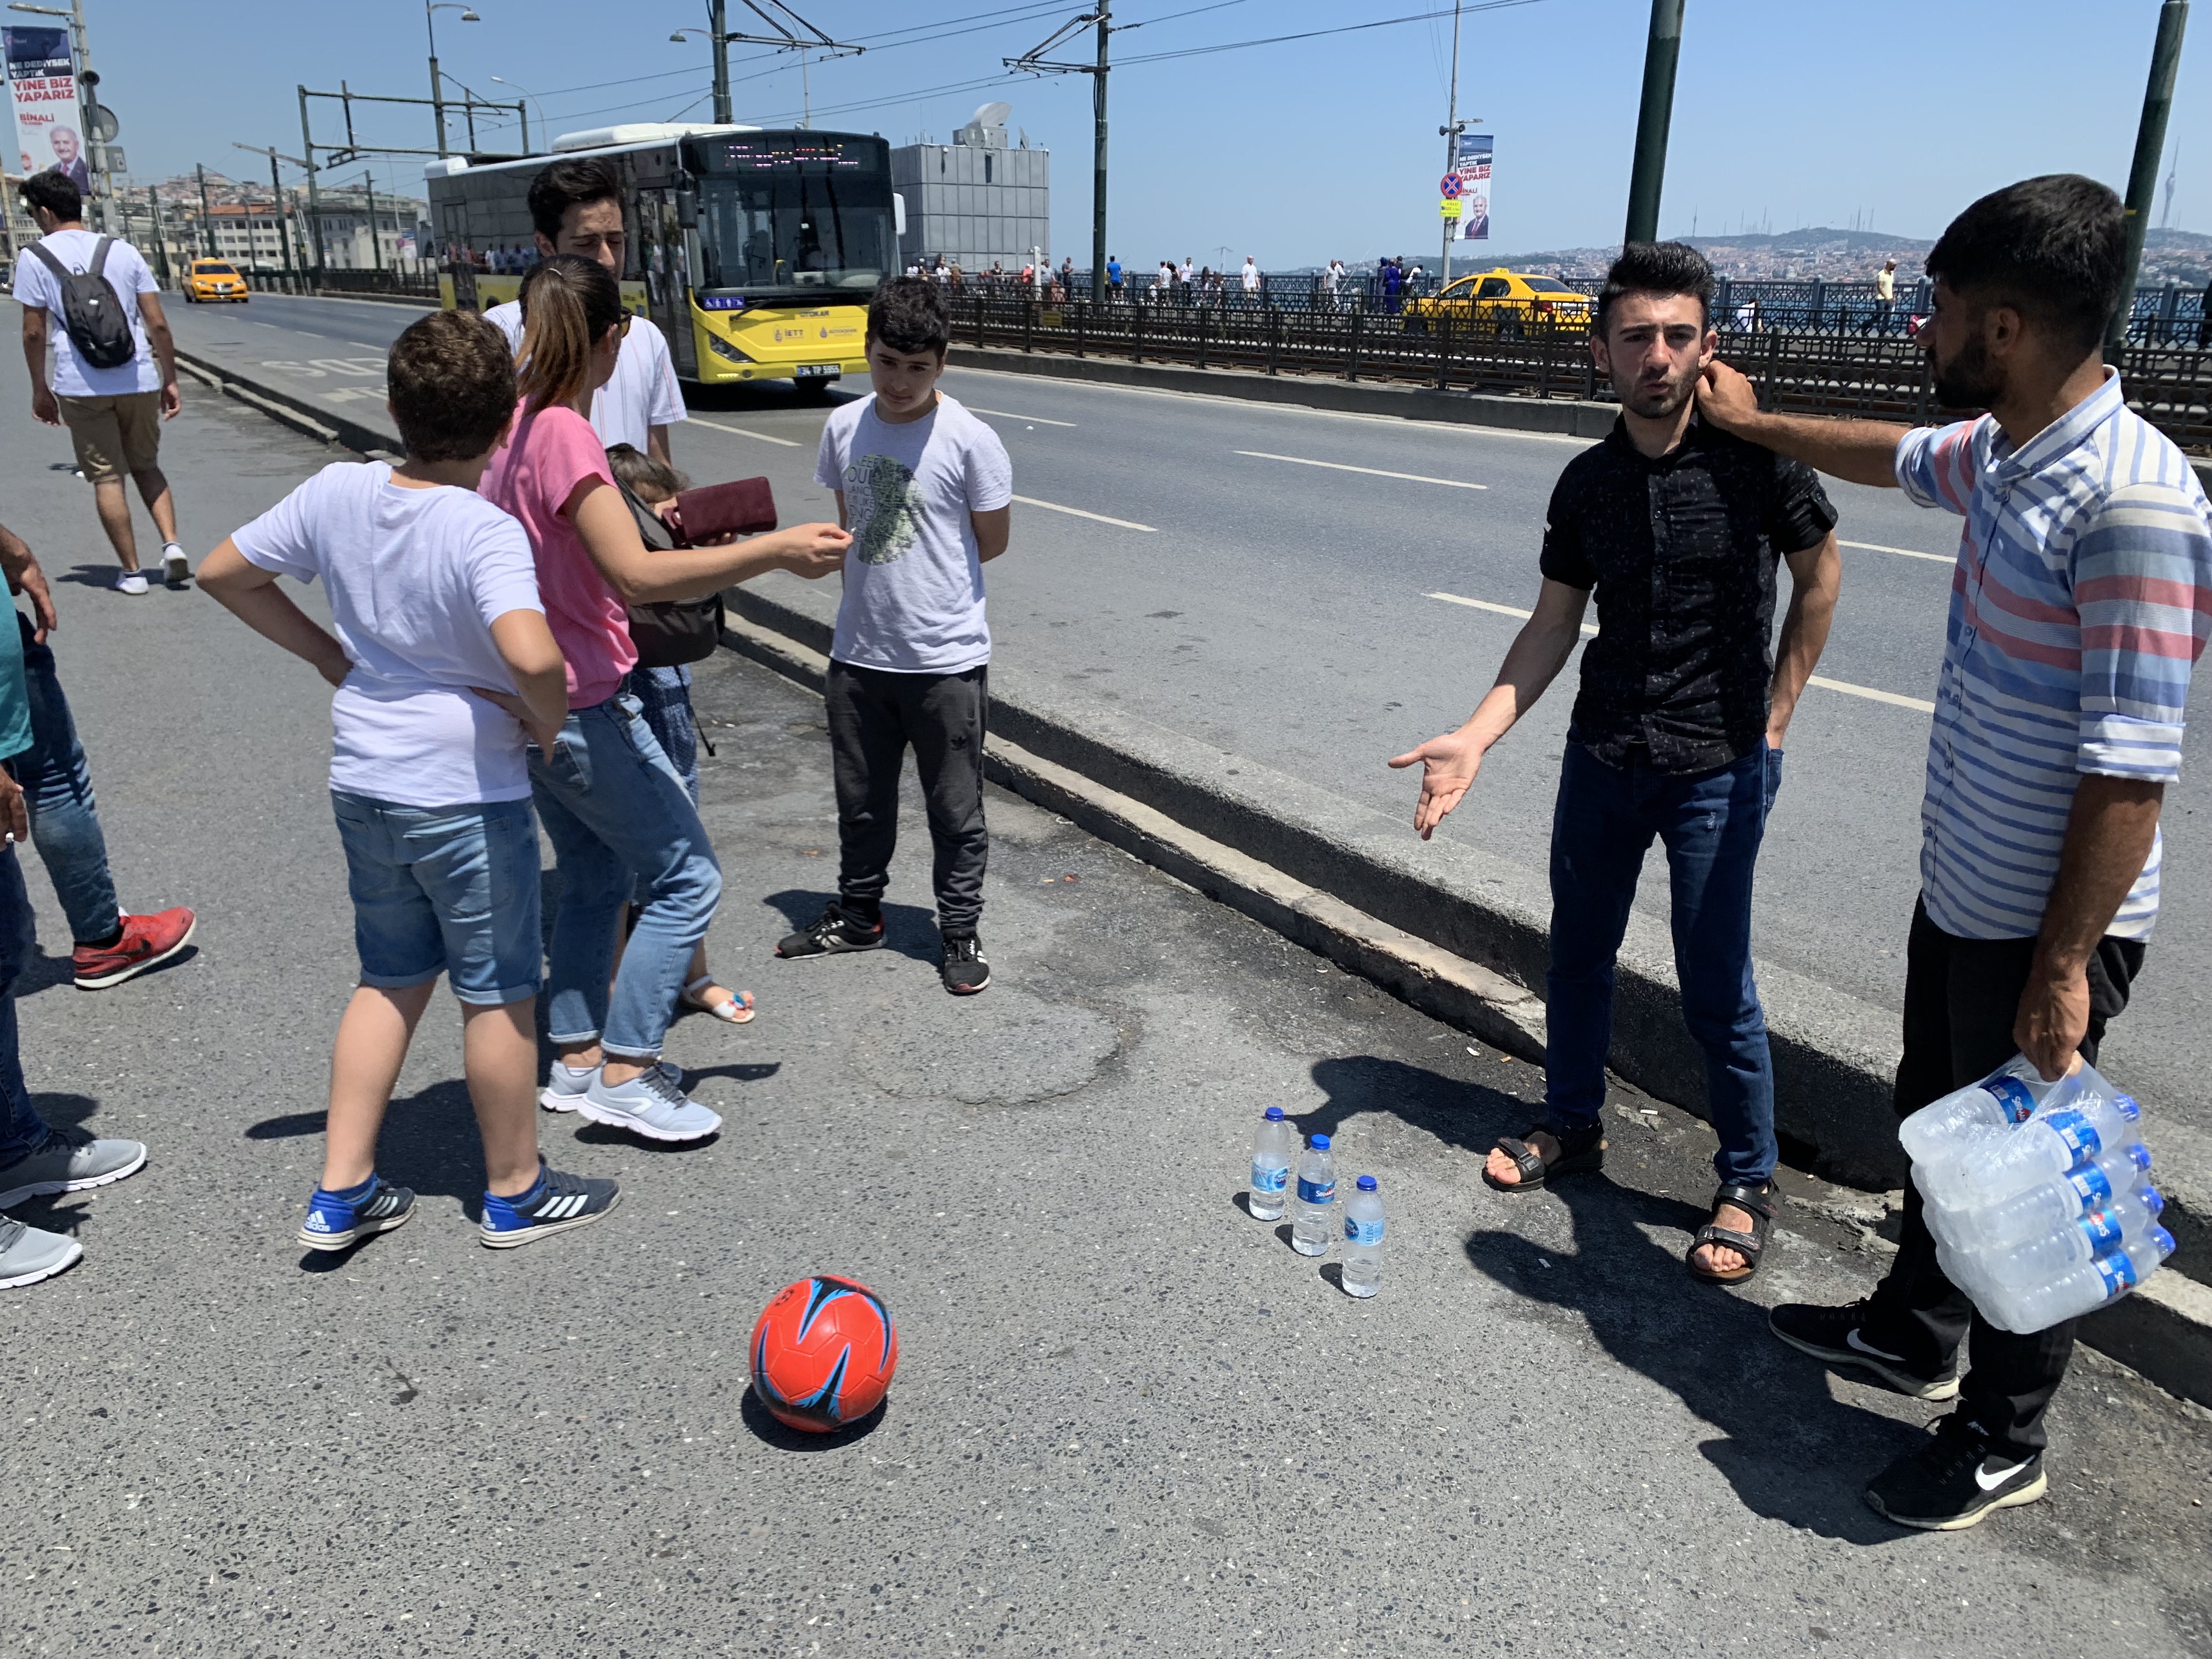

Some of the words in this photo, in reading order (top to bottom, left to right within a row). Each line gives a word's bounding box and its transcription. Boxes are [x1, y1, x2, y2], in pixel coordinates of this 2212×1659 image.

[13, 78, 47, 91] YİNE
[49, 77, 72, 88] BİZ
[15, 88, 75, 102] YAPARIZ
